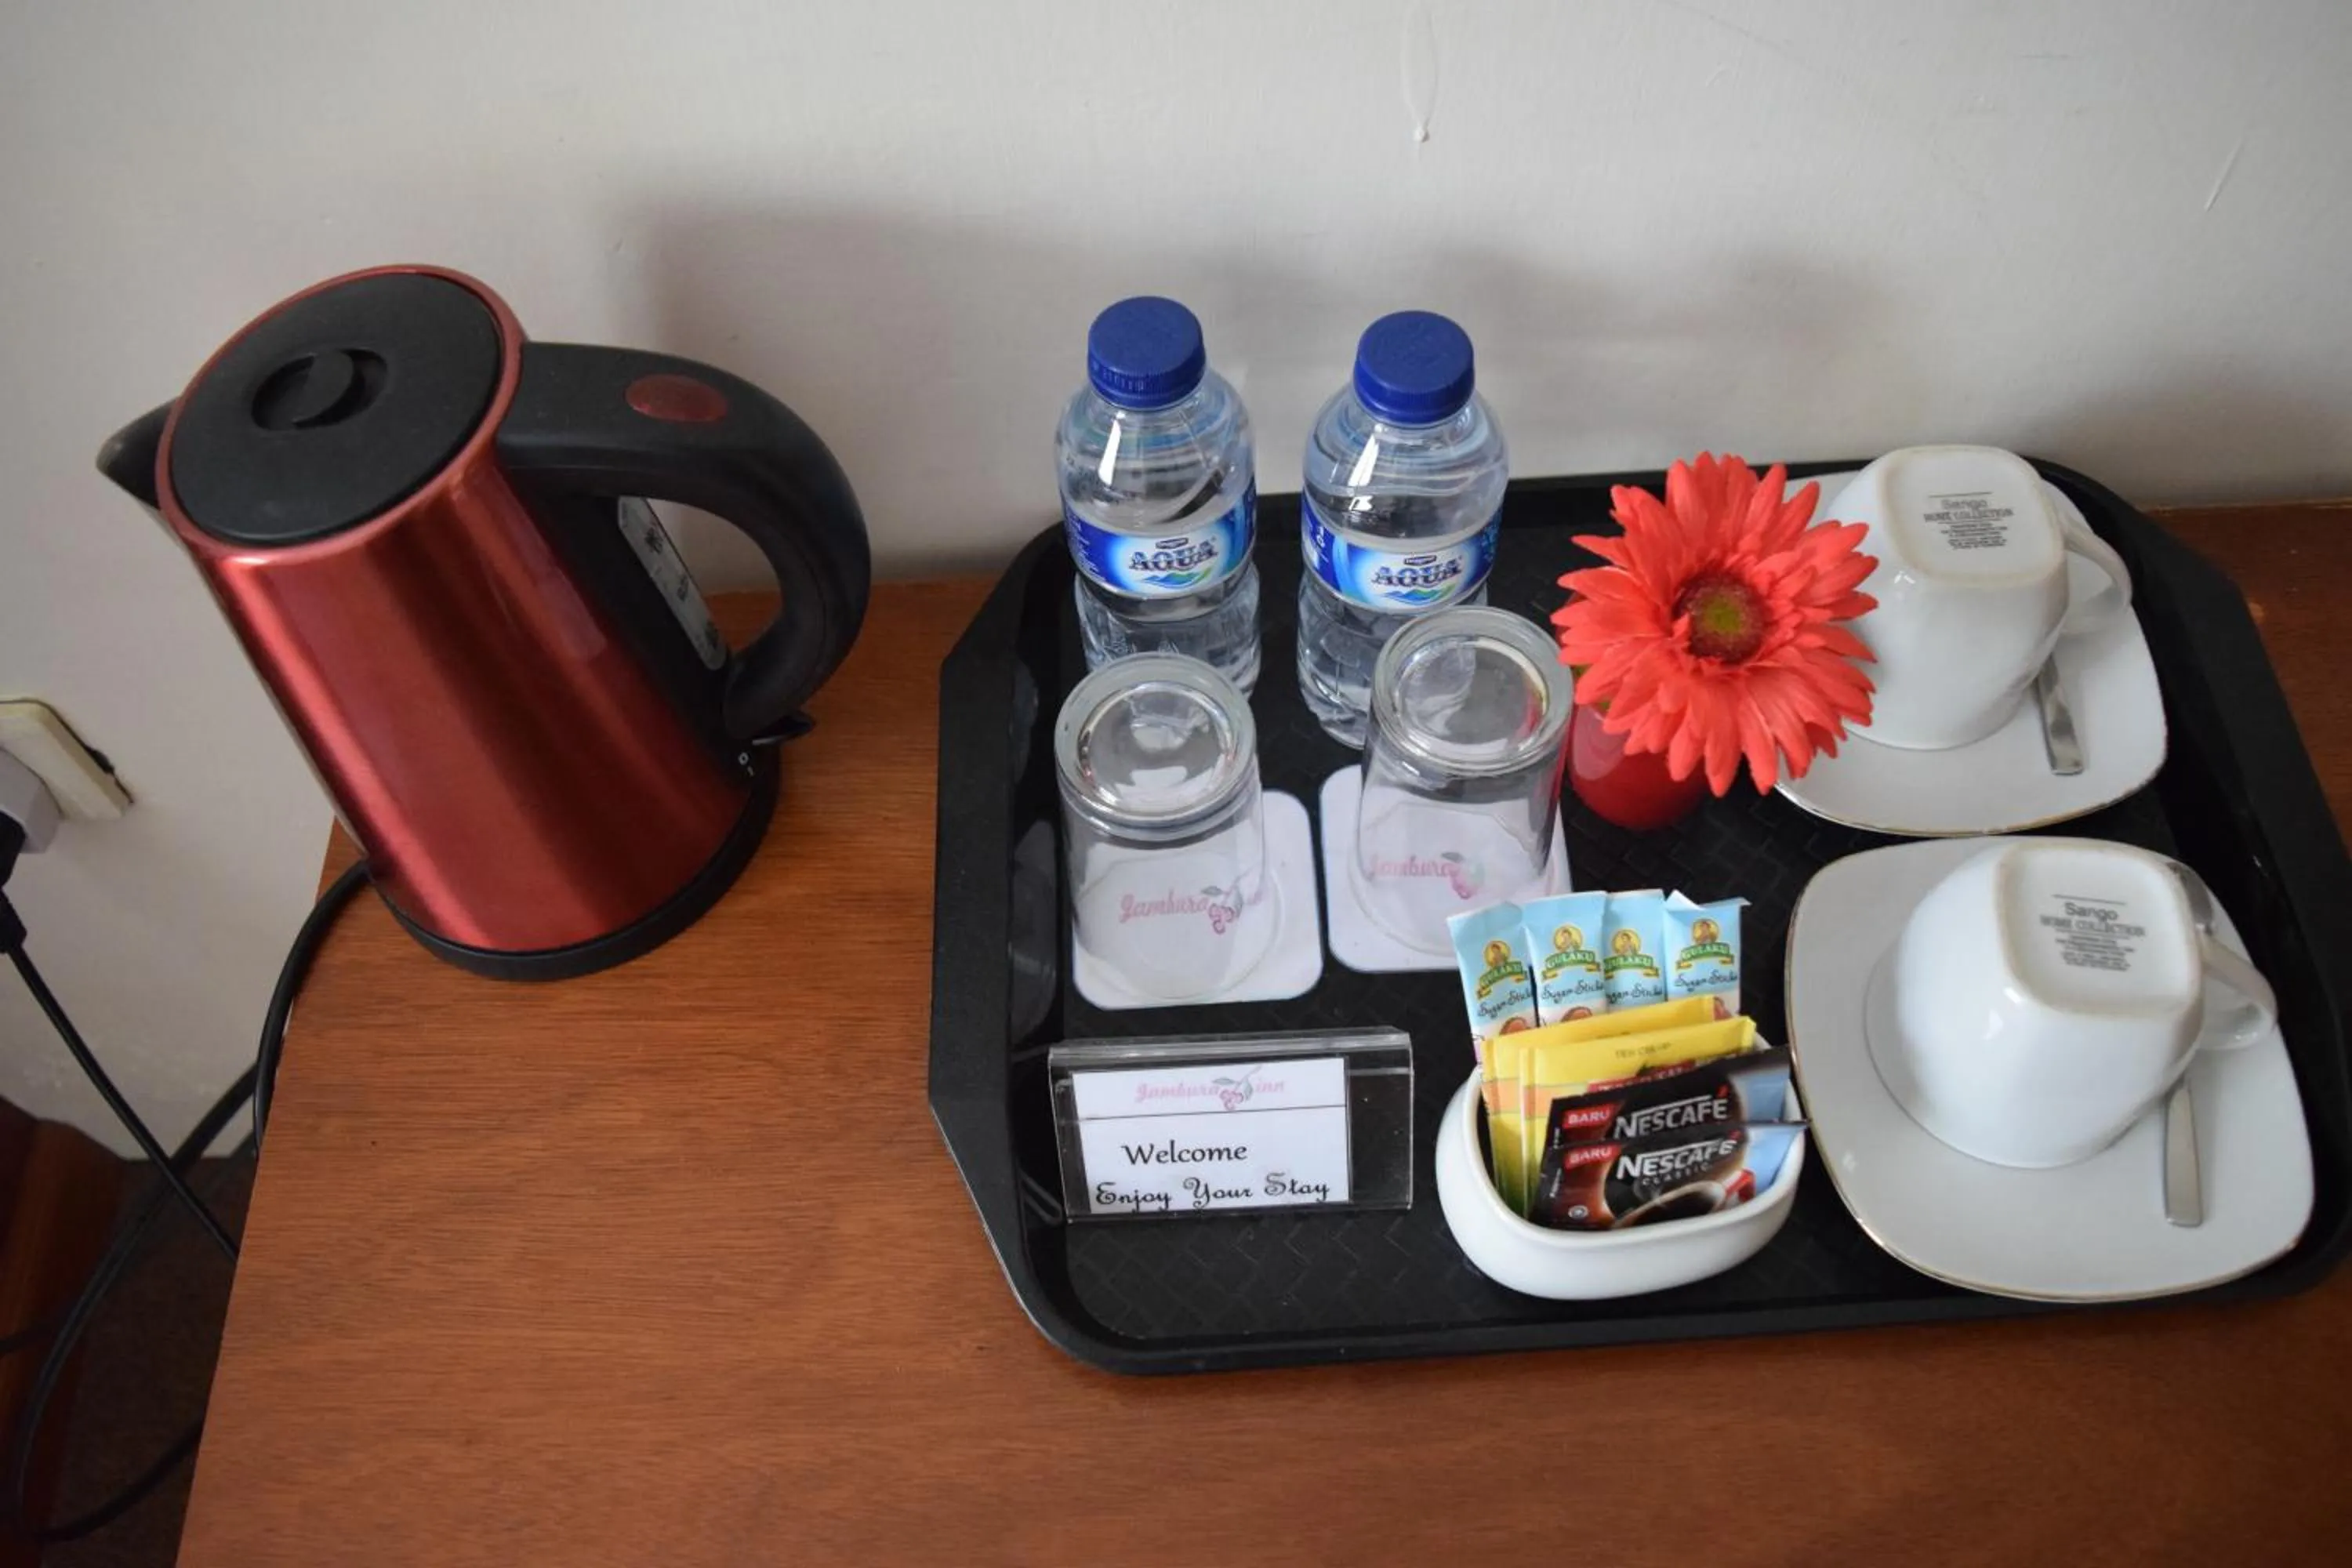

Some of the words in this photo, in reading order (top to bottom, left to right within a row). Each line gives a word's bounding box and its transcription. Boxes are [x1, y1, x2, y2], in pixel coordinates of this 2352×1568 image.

[1129, 539, 1218, 572] AQUA
[1370, 557, 1461, 588] AQUA
[2063, 902, 2120, 923] Sango
[1546, 952, 1594, 968] GULAKU
[1256, 1080, 1285, 1093] inn
[1569, 1109, 1611, 1125] BARU
[1121, 1139, 1248, 1166] Welcome
[1569, 1146, 1613, 1164] BARU
[1095, 1181, 1174, 1214] Enjoy
[1182, 1177, 1254, 1213] Your
[1264, 1172, 1330, 1203] Stay
